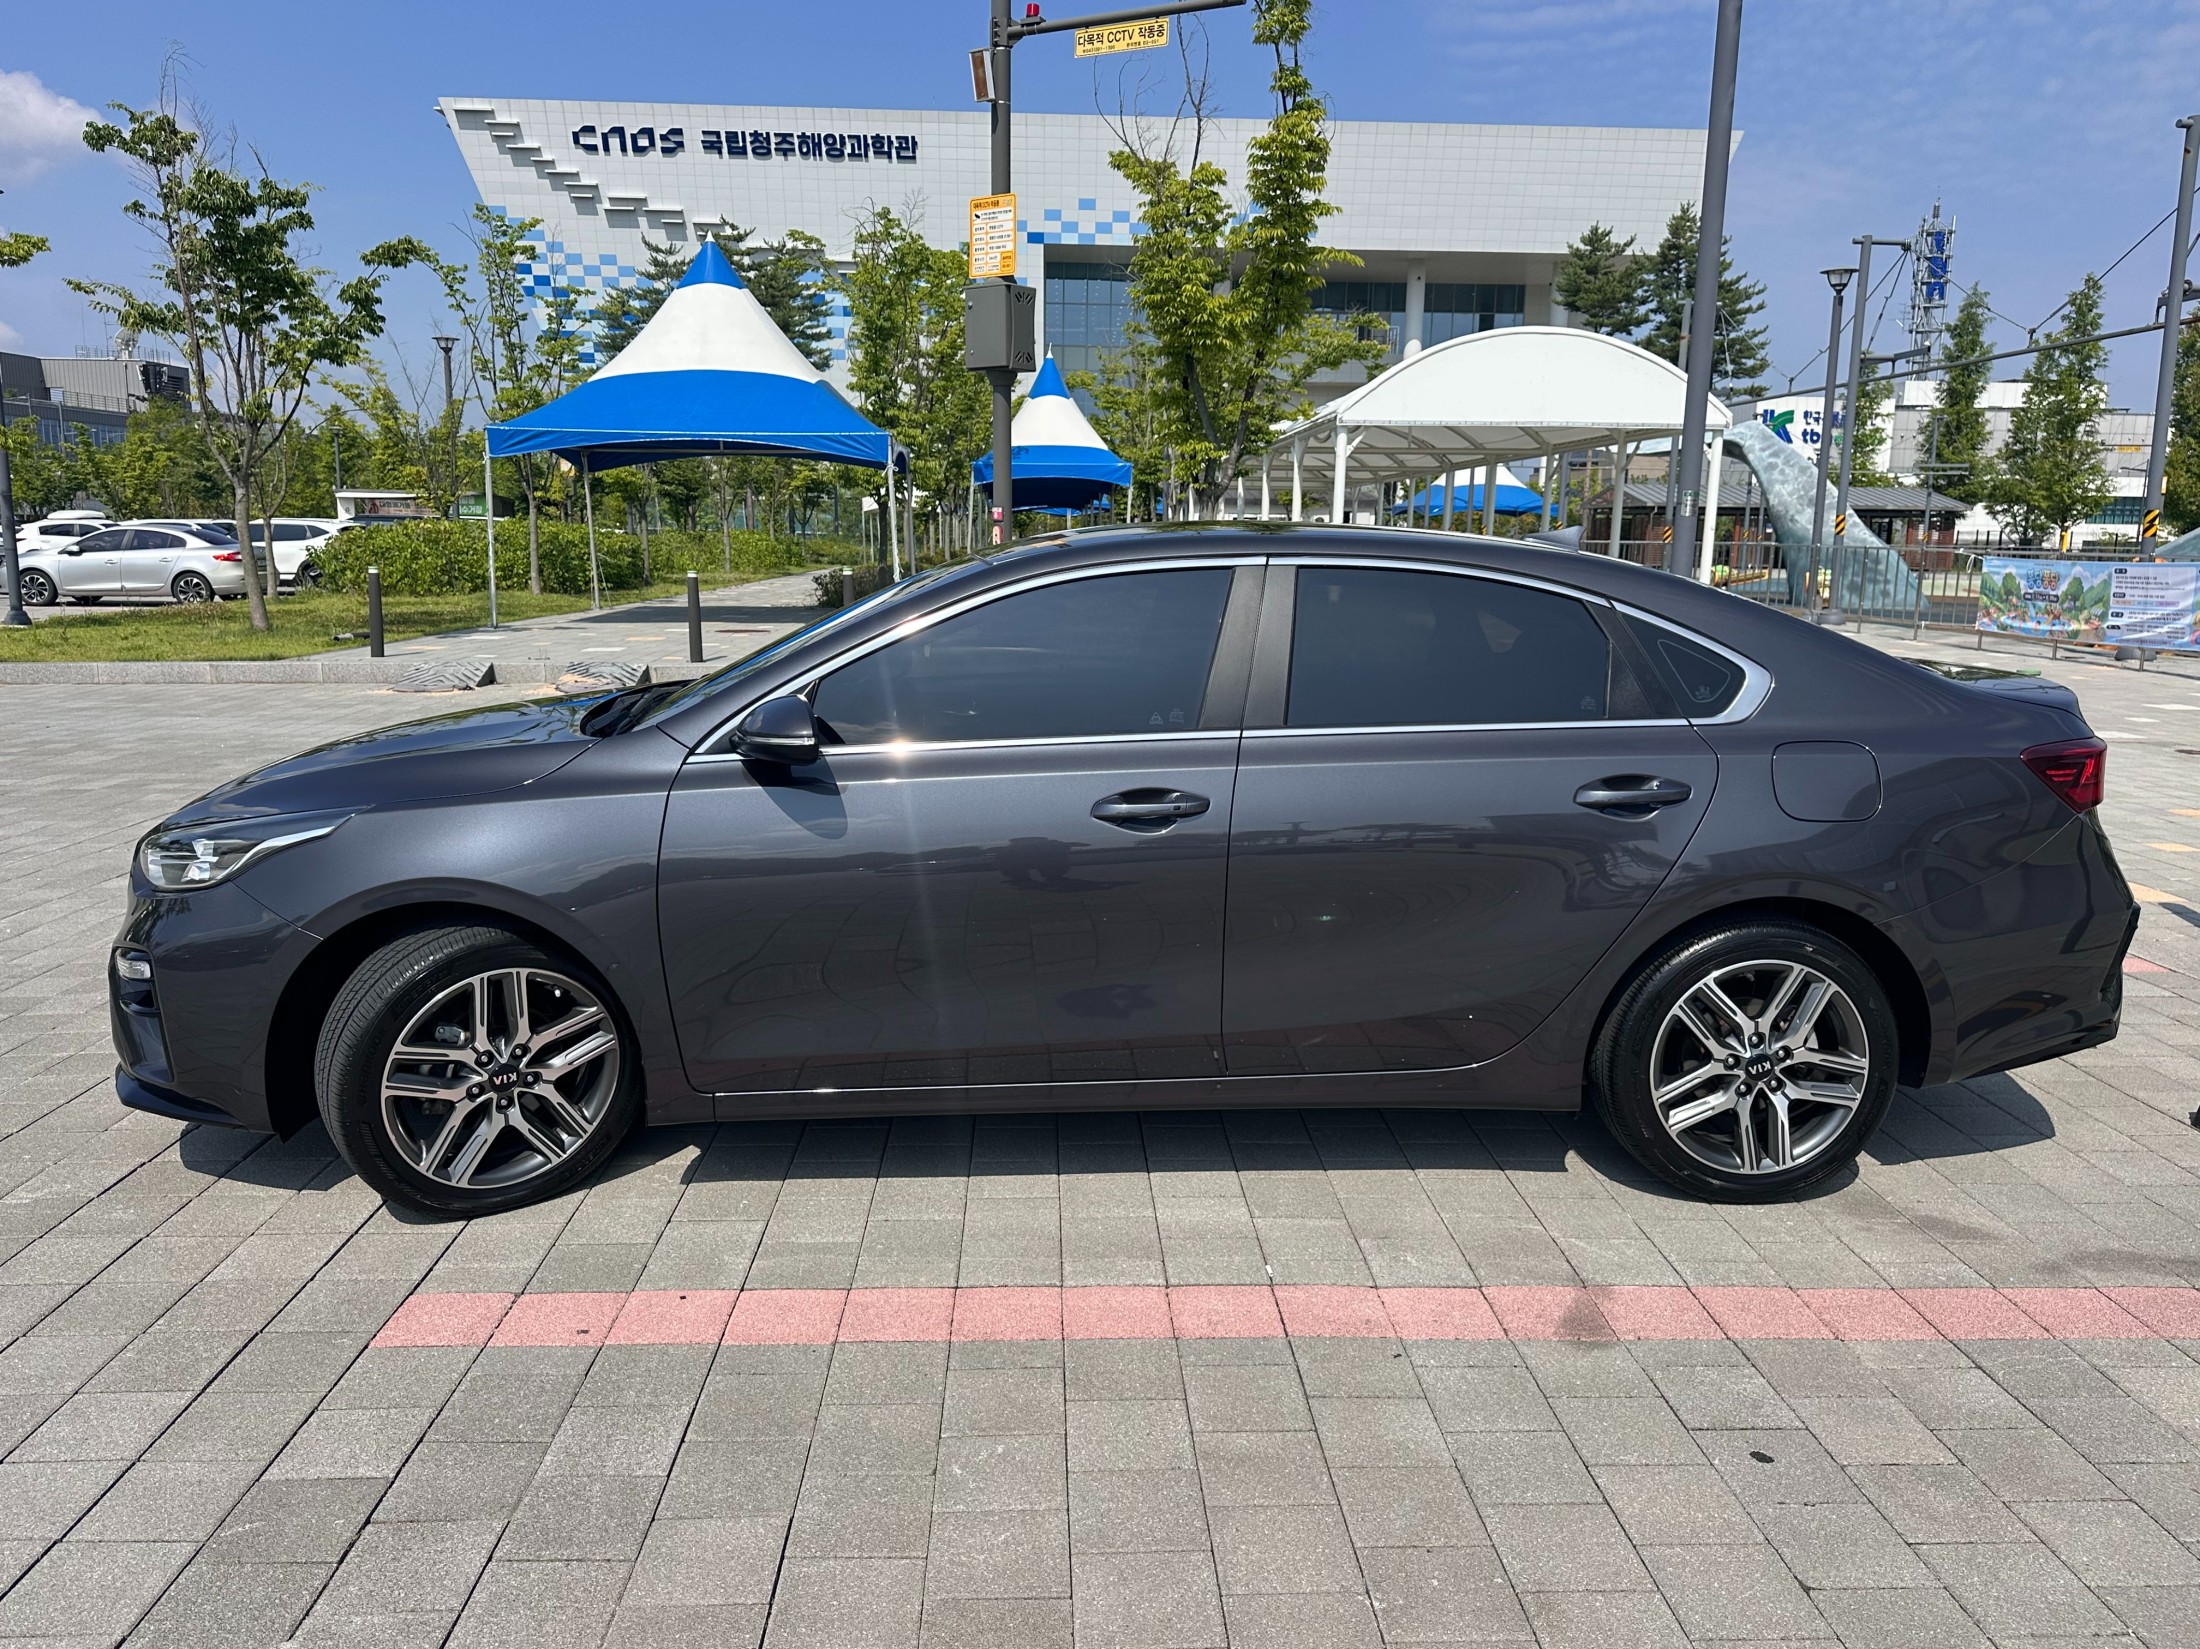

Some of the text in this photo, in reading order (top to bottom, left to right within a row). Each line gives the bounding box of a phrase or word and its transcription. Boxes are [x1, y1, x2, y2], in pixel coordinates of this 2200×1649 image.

[1078, 24, 1166, 47] 다목적 CCTV 작동중
[700, 129, 919, 162] 국립청주해양과학관
[1748, 1060, 1772, 1075] KIA
[492, 1072, 518, 1085] KIA
